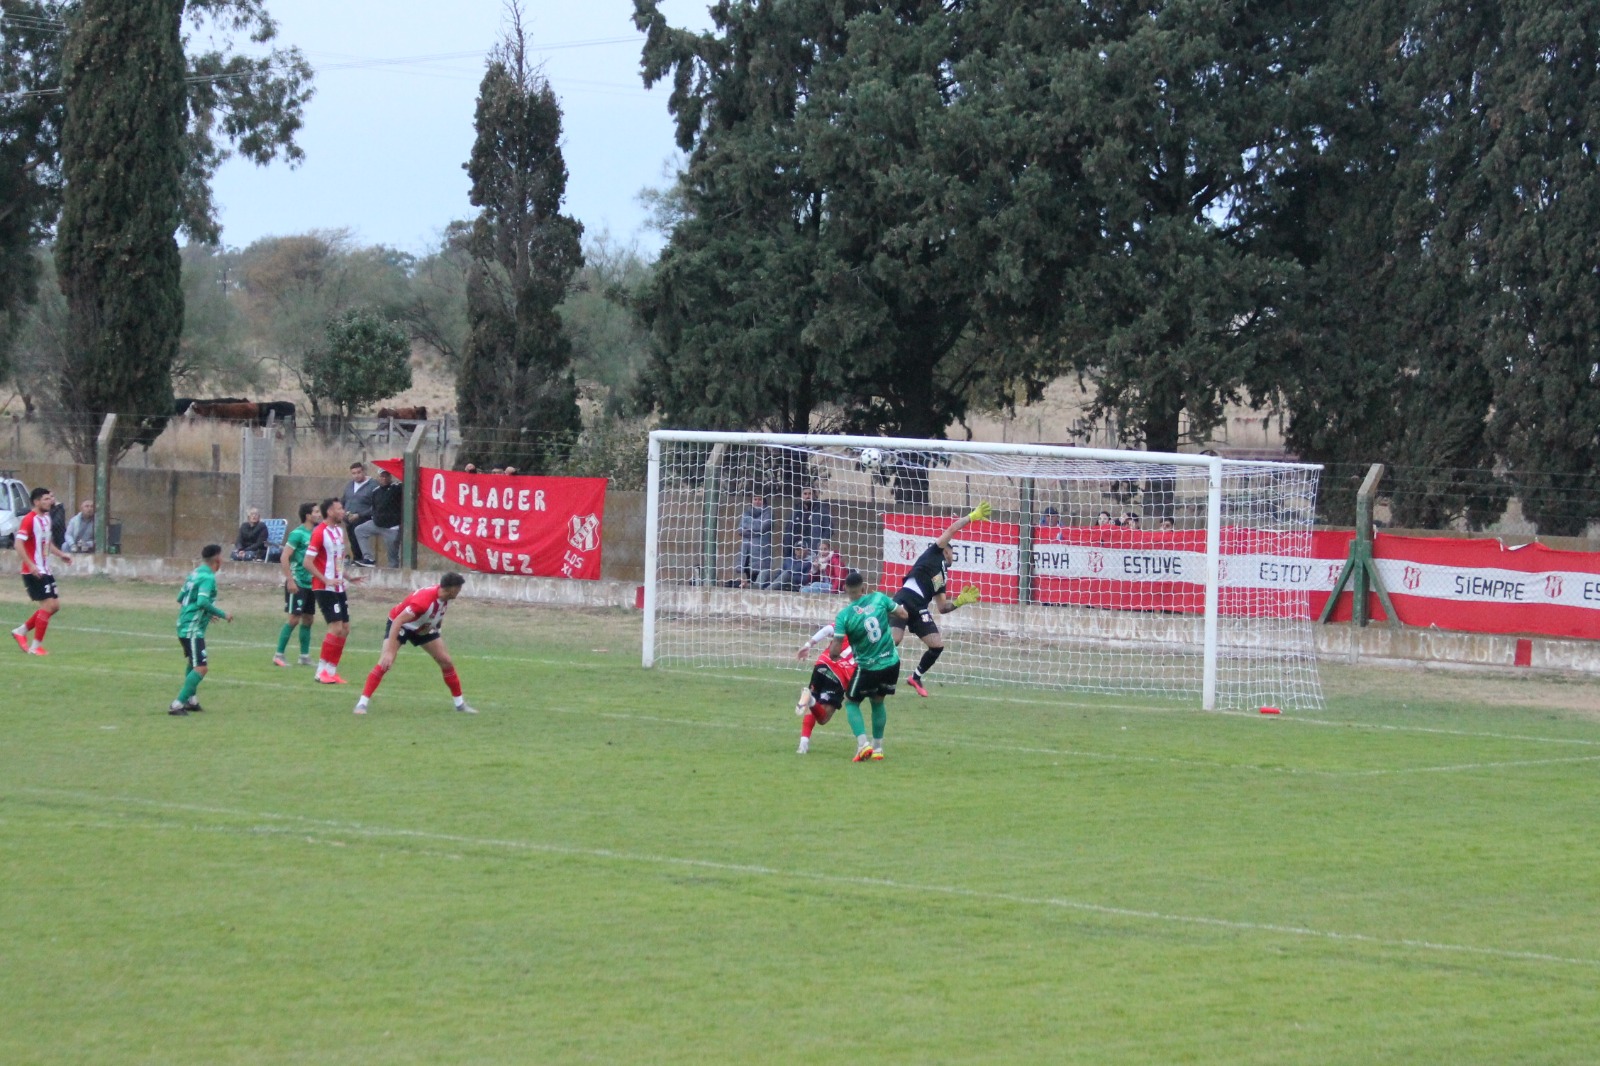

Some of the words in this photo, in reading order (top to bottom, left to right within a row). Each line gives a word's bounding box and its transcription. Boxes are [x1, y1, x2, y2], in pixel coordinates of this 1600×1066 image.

[432, 473, 445, 504] Q
[458, 483, 546, 512] PLACER
[486, 548, 533, 574] VEZ
[563, 550, 584, 569] LOS
[1032, 551, 1069, 570] RAVA
[1123, 555, 1182, 575] ESTUVE
[1259, 562, 1312, 583] ESTOY
[864, 616, 882, 644] 8
